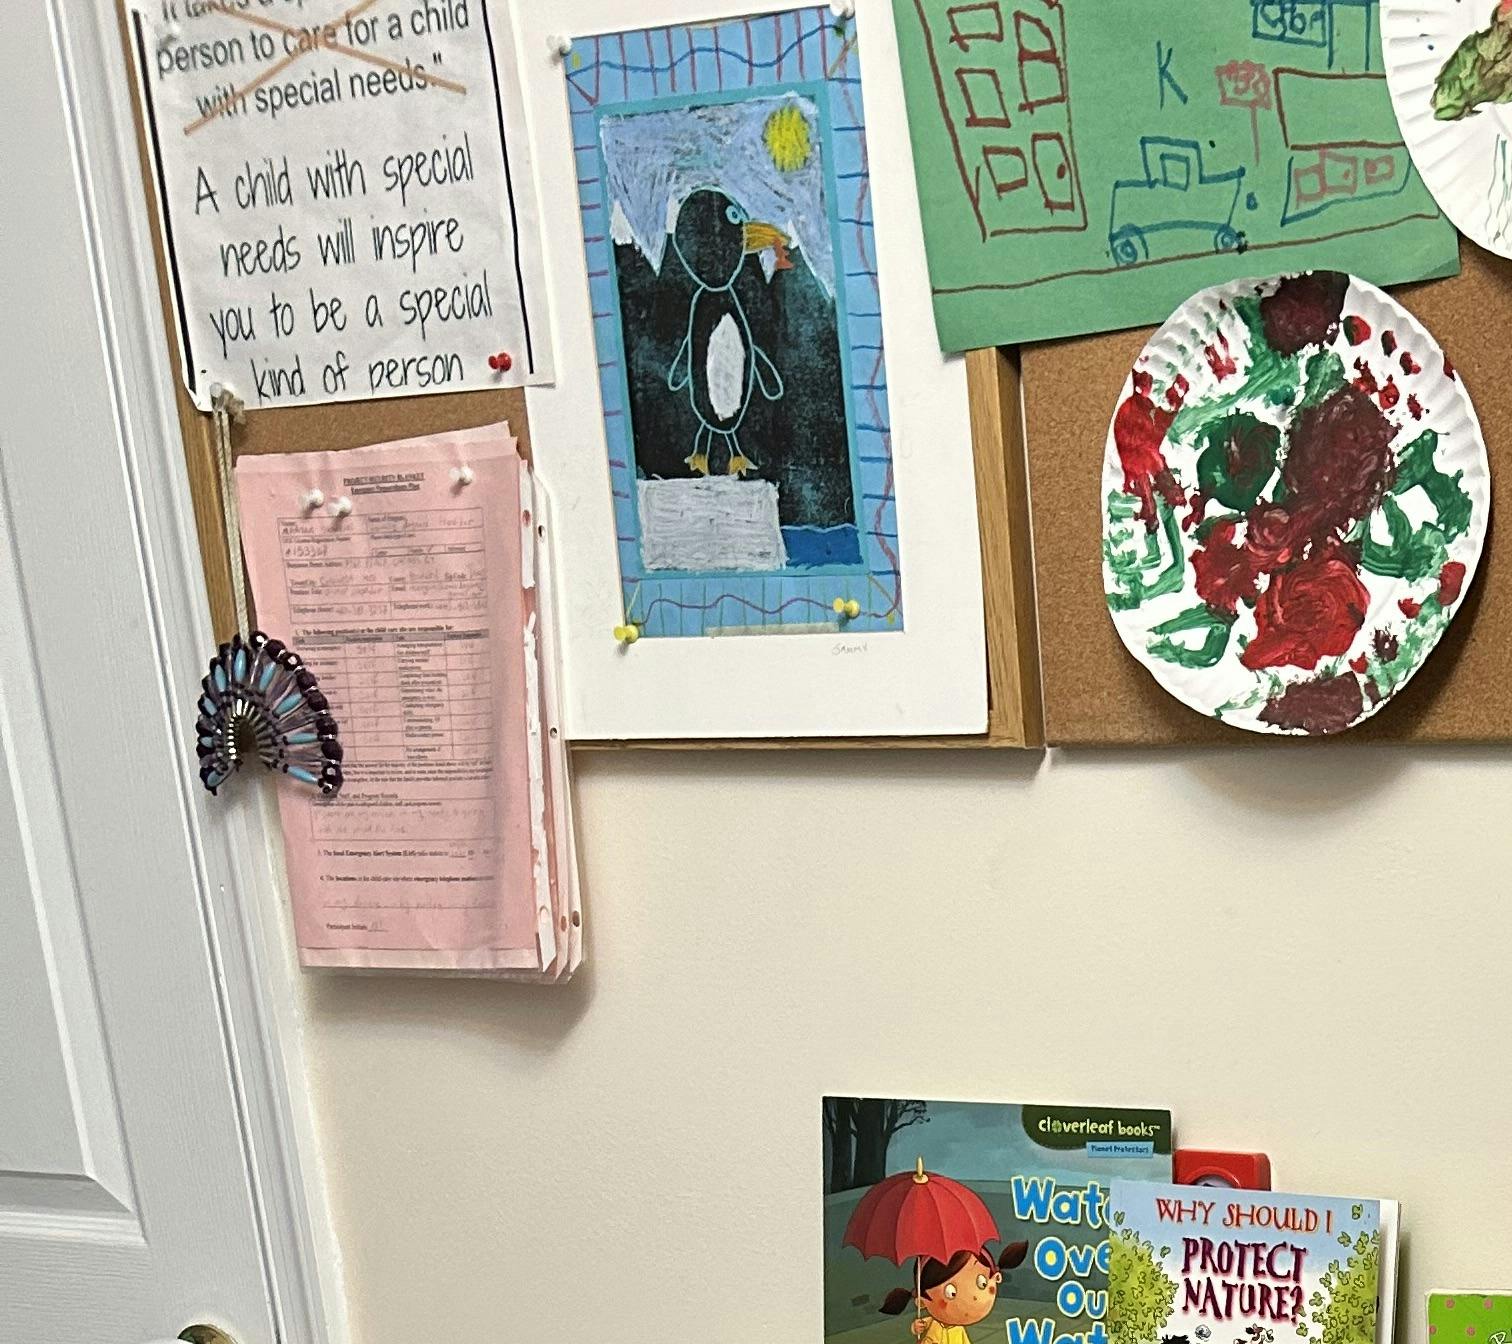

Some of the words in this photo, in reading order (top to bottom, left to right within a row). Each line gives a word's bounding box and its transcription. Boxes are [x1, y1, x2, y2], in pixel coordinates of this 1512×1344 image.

[156, 38, 245, 80] person
[250, 33, 274, 60] to
[345, 14, 378, 46] for
[387, 16, 403, 40] a
[410, 2, 468, 35] child
[196, 83, 247, 120] with
[255, 67, 341, 120] special
[194, 167, 218, 215] A
[234, 157, 294, 210] child
[307, 149, 366, 200] with
[383, 132, 475, 206] special
[220, 226, 301, 278] needs
[317, 219, 356, 267] will
[372, 208, 464, 275] inspire
[209, 312, 256, 360] you
[270, 292, 294, 338] to
[310, 288, 346, 333] be
[365, 294, 383, 327] a
[399, 269, 494, 336] special
[252, 358, 306, 402] kind
[323, 351, 349, 393] of
[368, 351, 464, 394] person
[1155, 1198, 1217, 1222] WHY
[1225, 1203, 1320, 1233] SHOULD
[1181, 1237, 1308, 1283] PROTECT
[1181, 1277, 1305, 1324] NATURE?
